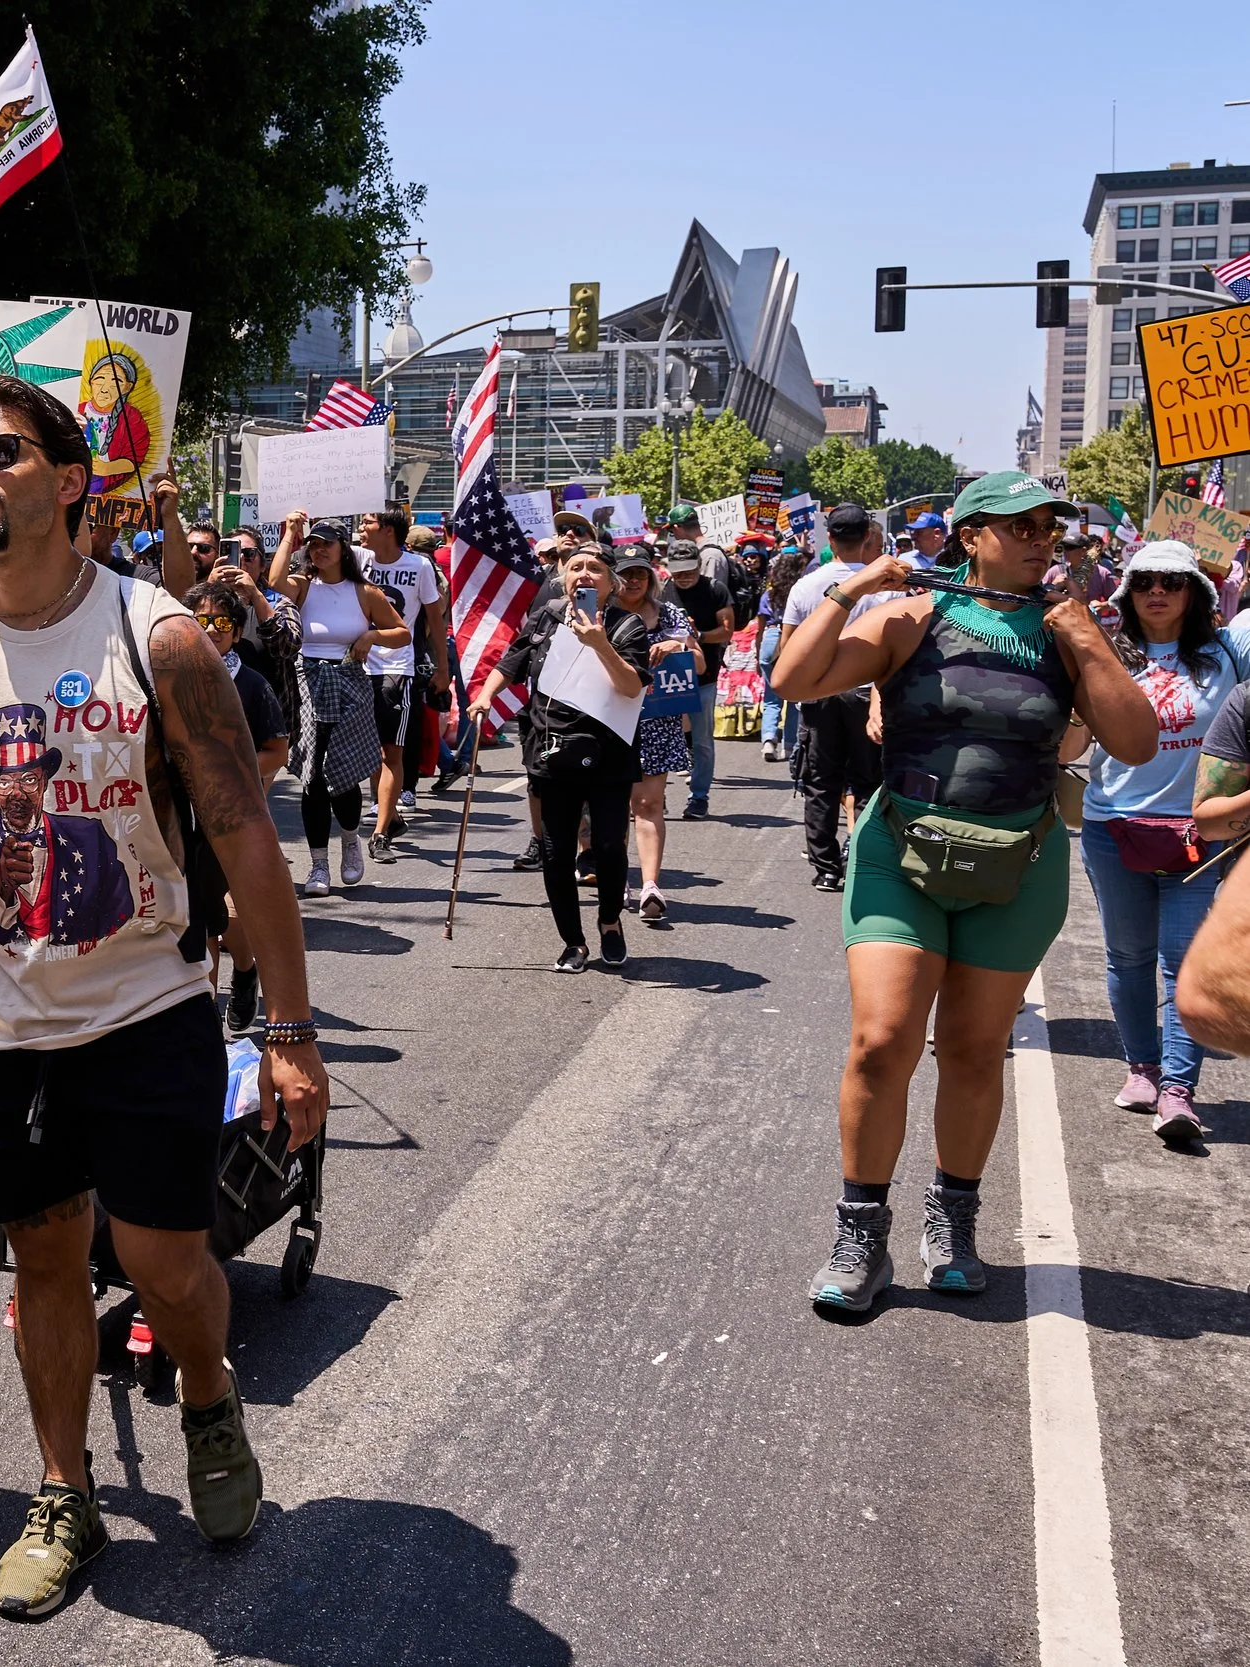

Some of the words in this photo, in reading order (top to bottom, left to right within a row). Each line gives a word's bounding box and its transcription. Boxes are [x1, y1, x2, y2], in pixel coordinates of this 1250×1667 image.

[106, 305, 179, 336] WORLD
[1157, 324, 1188, 347] 47
[759, 506, 778, 519] 1865
[1164, 495, 1193, 515] NO
[394, 570, 418, 587] ICE
